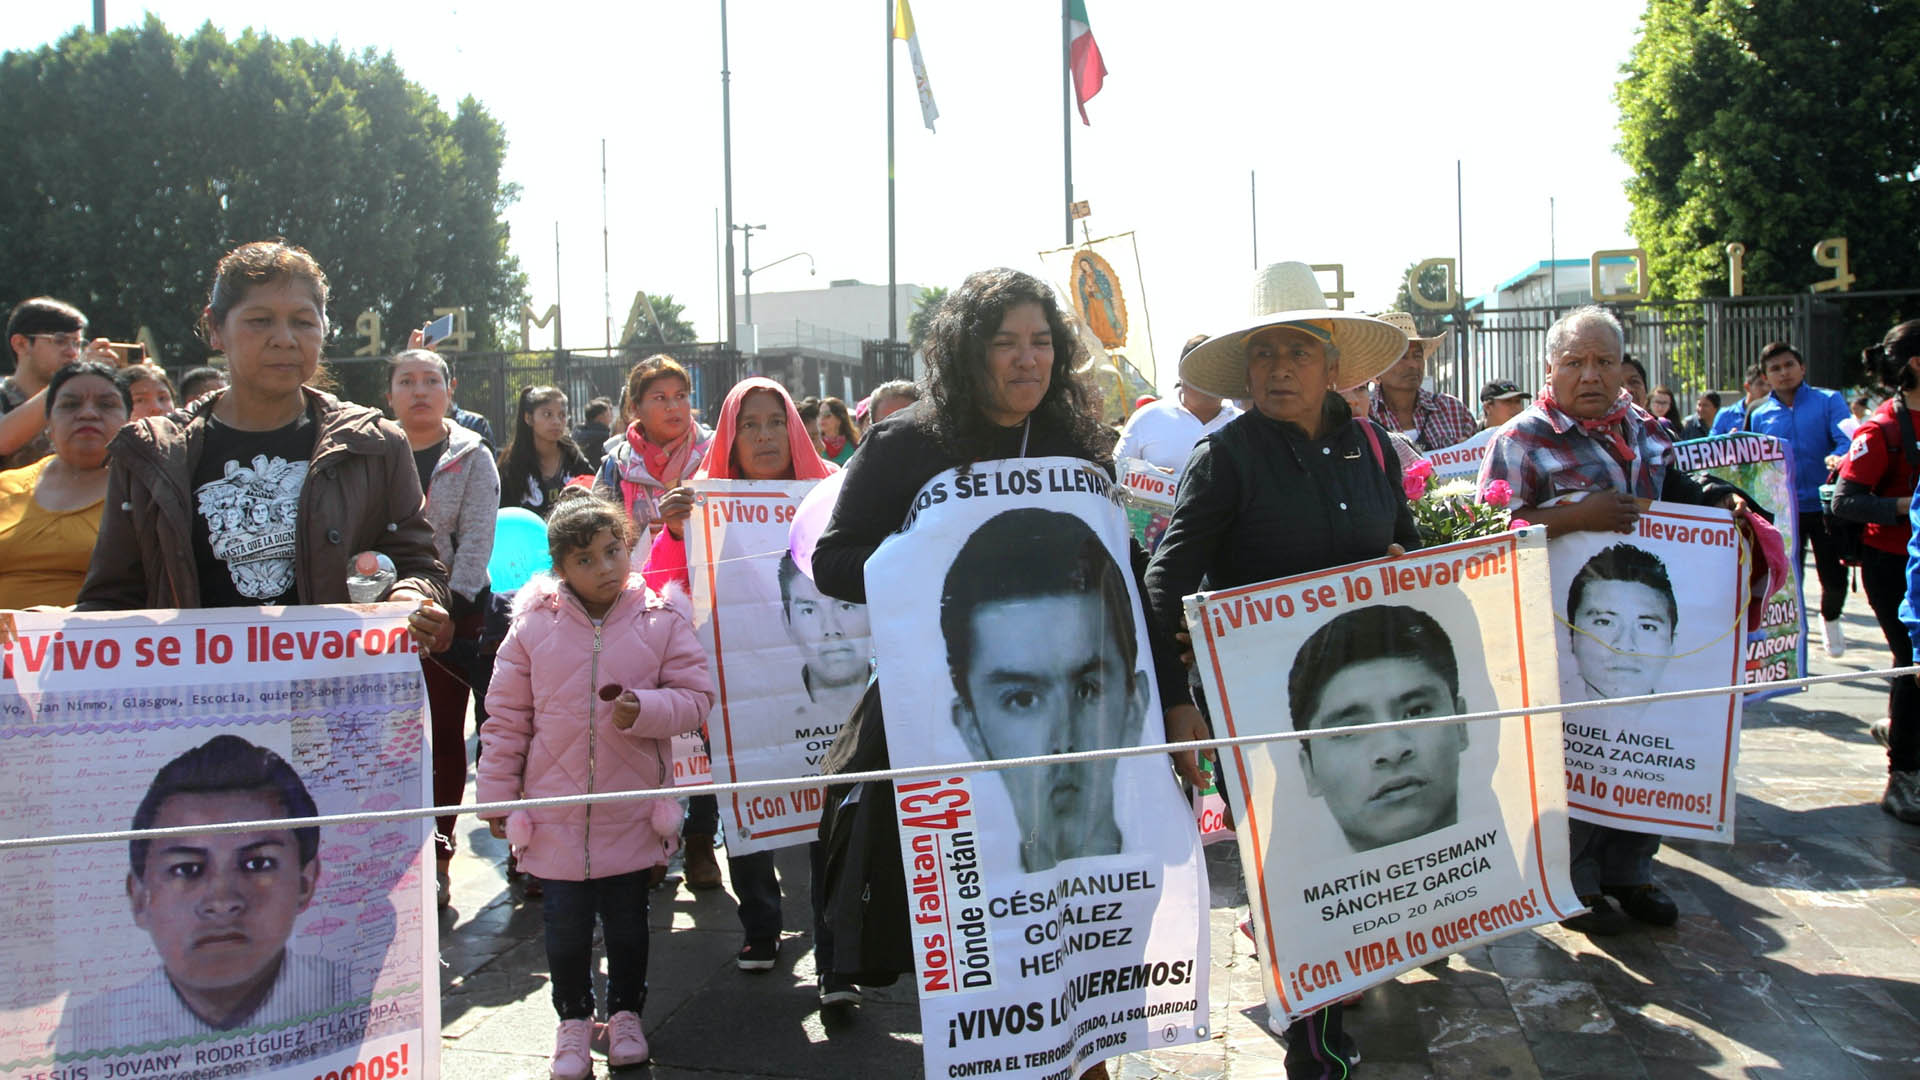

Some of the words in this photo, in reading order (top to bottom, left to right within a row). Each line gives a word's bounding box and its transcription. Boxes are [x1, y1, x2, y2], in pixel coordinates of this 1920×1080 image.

[1430, 447, 1486, 467] llevaro
[1674, 435, 1784, 472] HERNANDEZ
[955, 473, 988, 499] SE
[995, 469, 1042, 495] LOS
[1123, 472, 1164, 494] ¡Vivo
[1167, 484, 1176, 496] s
[712, 500, 768, 527] ¡Vivo
[775, 504, 795, 524] se
[220, 544, 247, 559] HASTA
[247, 538, 263, 551] QUE
[263, 535, 274, 546] LA
[274, 530, 296, 544] DIGN
[1639, 517, 1735, 548] llevaron!
[1212, 595, 1295, 638] ¡Vivo
[1302, 585, 1337, 613] se
[1343, 575, 1373, 604] lo
[1380, 546, 1507, 596] llevaron!
[2, 631, 121, 680] ¡Vivo
[136, 635, 181, 667] se
[195, 627, 233, 665] lo
[1746, 632, 1798, 661] VARON
[1745, 661, 1787, 684] EMOS
[3, 704, 25, 715] Yo,
[36, 702, 59, 713] Jan
[67, 699, 114, 711] Nimmo,
[122, 697, 184, 709] Glasgow,
[192, 692, 251, 705] Escocia,
[259, 688, 304, 704] quiero
[311, 686, 345, 698] saber
[806, 738, 836, 751] OR
[1562, 721, 1612, 742] IGUEL
[1616, 729, 1675, 750] ÁNGEL
[1563, 738, 1605, 759] DOZA
[1609, 748, 1696, 770] ZACARIAS
[1565, 757, 1595, 771] DAD
[1599, 765, 1617, 776] 33
[1622, 768, 1665, 782] AÑOS
[745, 795, 786, 825] ¡Con
[897, 776, 972, 830] 43!
[1590, 775, 1607, 799] lo
[1612, 784, 1713, 815] queremos!
[912, 833, 942, 925] faltan
[946, 831, 982, 900] están
[1303, 868, 1381, 904] MARTÍN
[1386, 829, 1498, 880] GETSEMANY
[1057, 870, 1156, 900] MANUEL
[1321, 881, 1420, 922] SÁNCHEZ
[1423, 856, 1492, 892] GARCÍA
[1353, 912, 1401, 935] EDAD
[1407, 904, 1427, 919] 20
[1433, 886, 1478, 911] AÑOS
[957, 906, 992, 988] Dónde
[1290, 959, 1342, 1001] ¡Con
[1345, 937, 1404, 977] VIDA
[1406, 931, 1427, 958] lo
[1431, 888, 1543, 949] queremos!
[923, 933, 950, 992] Nos
[948, 1001, 1044, 1048] ¡VIVOS
[1069, 959, 1194, 1011] QUEREMOS!
[104, 1053, 182, 1079] JOVANY
[195, 1030, 306, 1065] RODRÍGUEZ
[318, 1001, 400, 1037] TLATEMPA
[948, 1056, 1002, 1079] CONTRA
[1005, 1053, 1022, 1071] EL
[1078, 1014, 1108, 1039] ESTADO,
[1111, 1010, 1124, 1025] LA
[1126, 999, 1198, 1020] SOLIDARIDAD
[1096, 1031, 1127, 1052] TODXS
